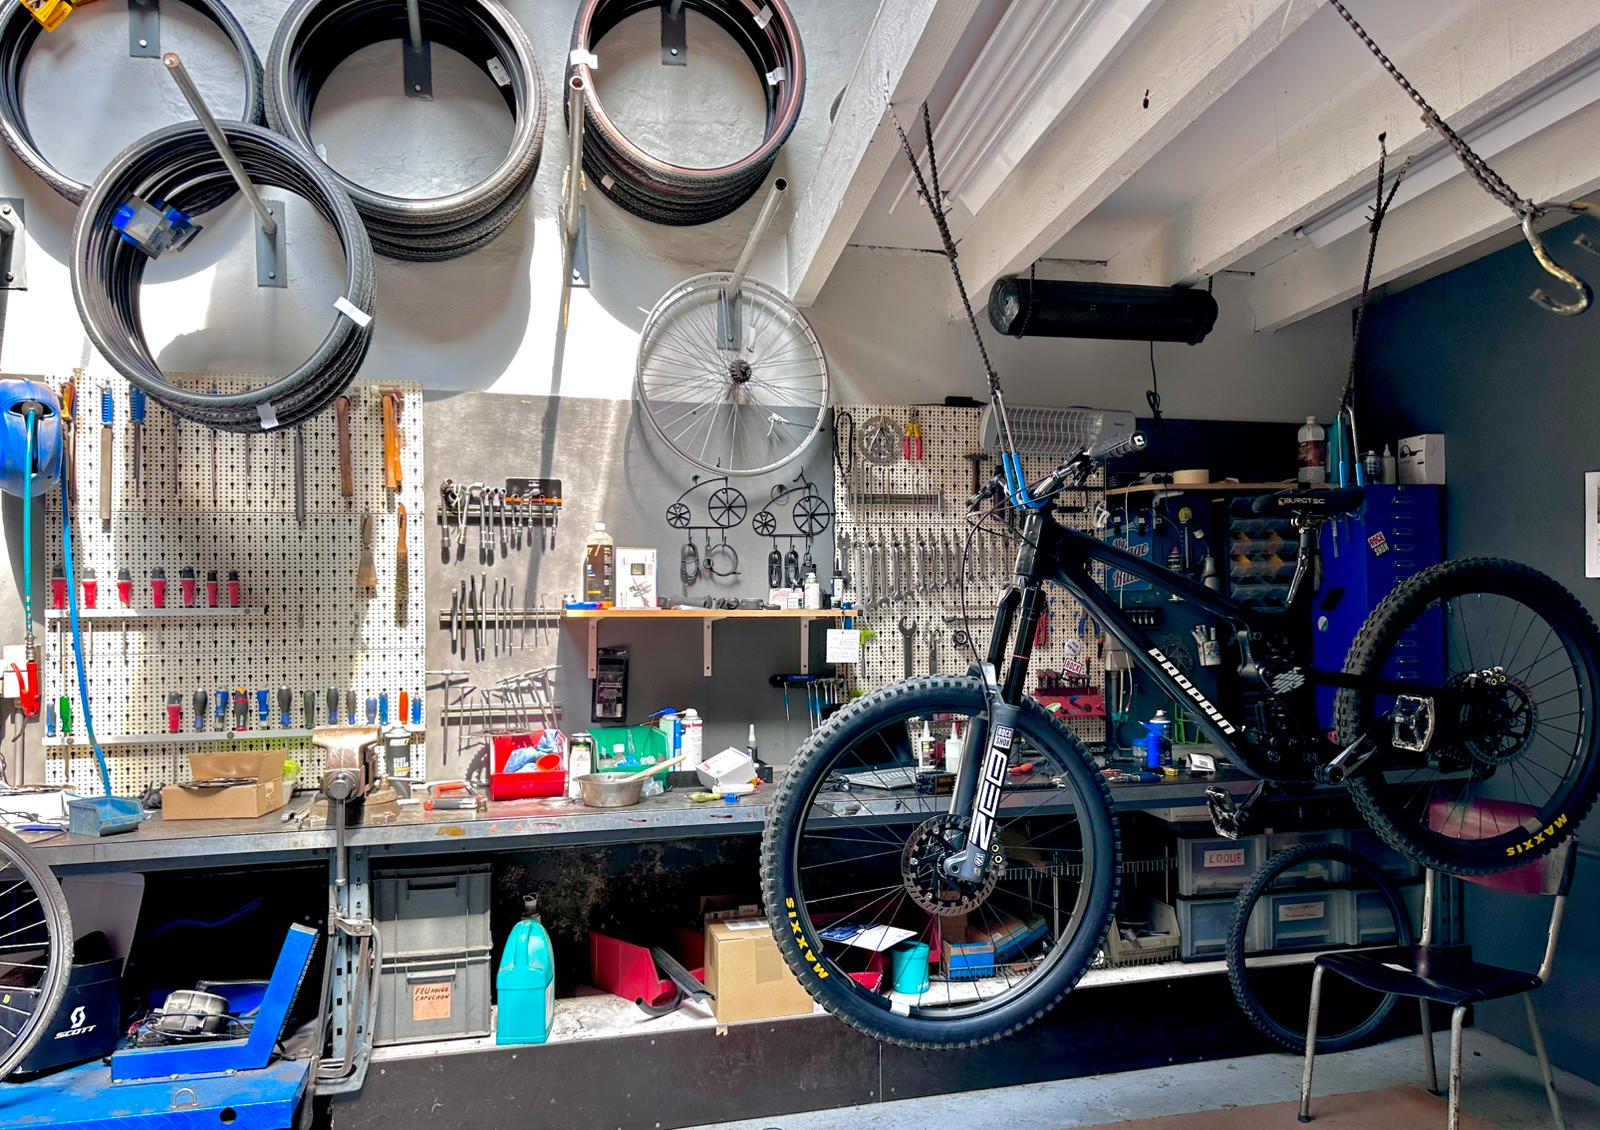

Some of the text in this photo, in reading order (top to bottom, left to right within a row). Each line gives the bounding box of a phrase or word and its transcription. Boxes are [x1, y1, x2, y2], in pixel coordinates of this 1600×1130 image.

[1147, 647, 1236, 735] PROPAIN
[972, 747, 1008, 851] ZEB
[1506, 813, 1567, 856] MAXXIS
[786, 897, 829, 979] MAXXIS
[54, 1024, 97, 1039] SCOTT
